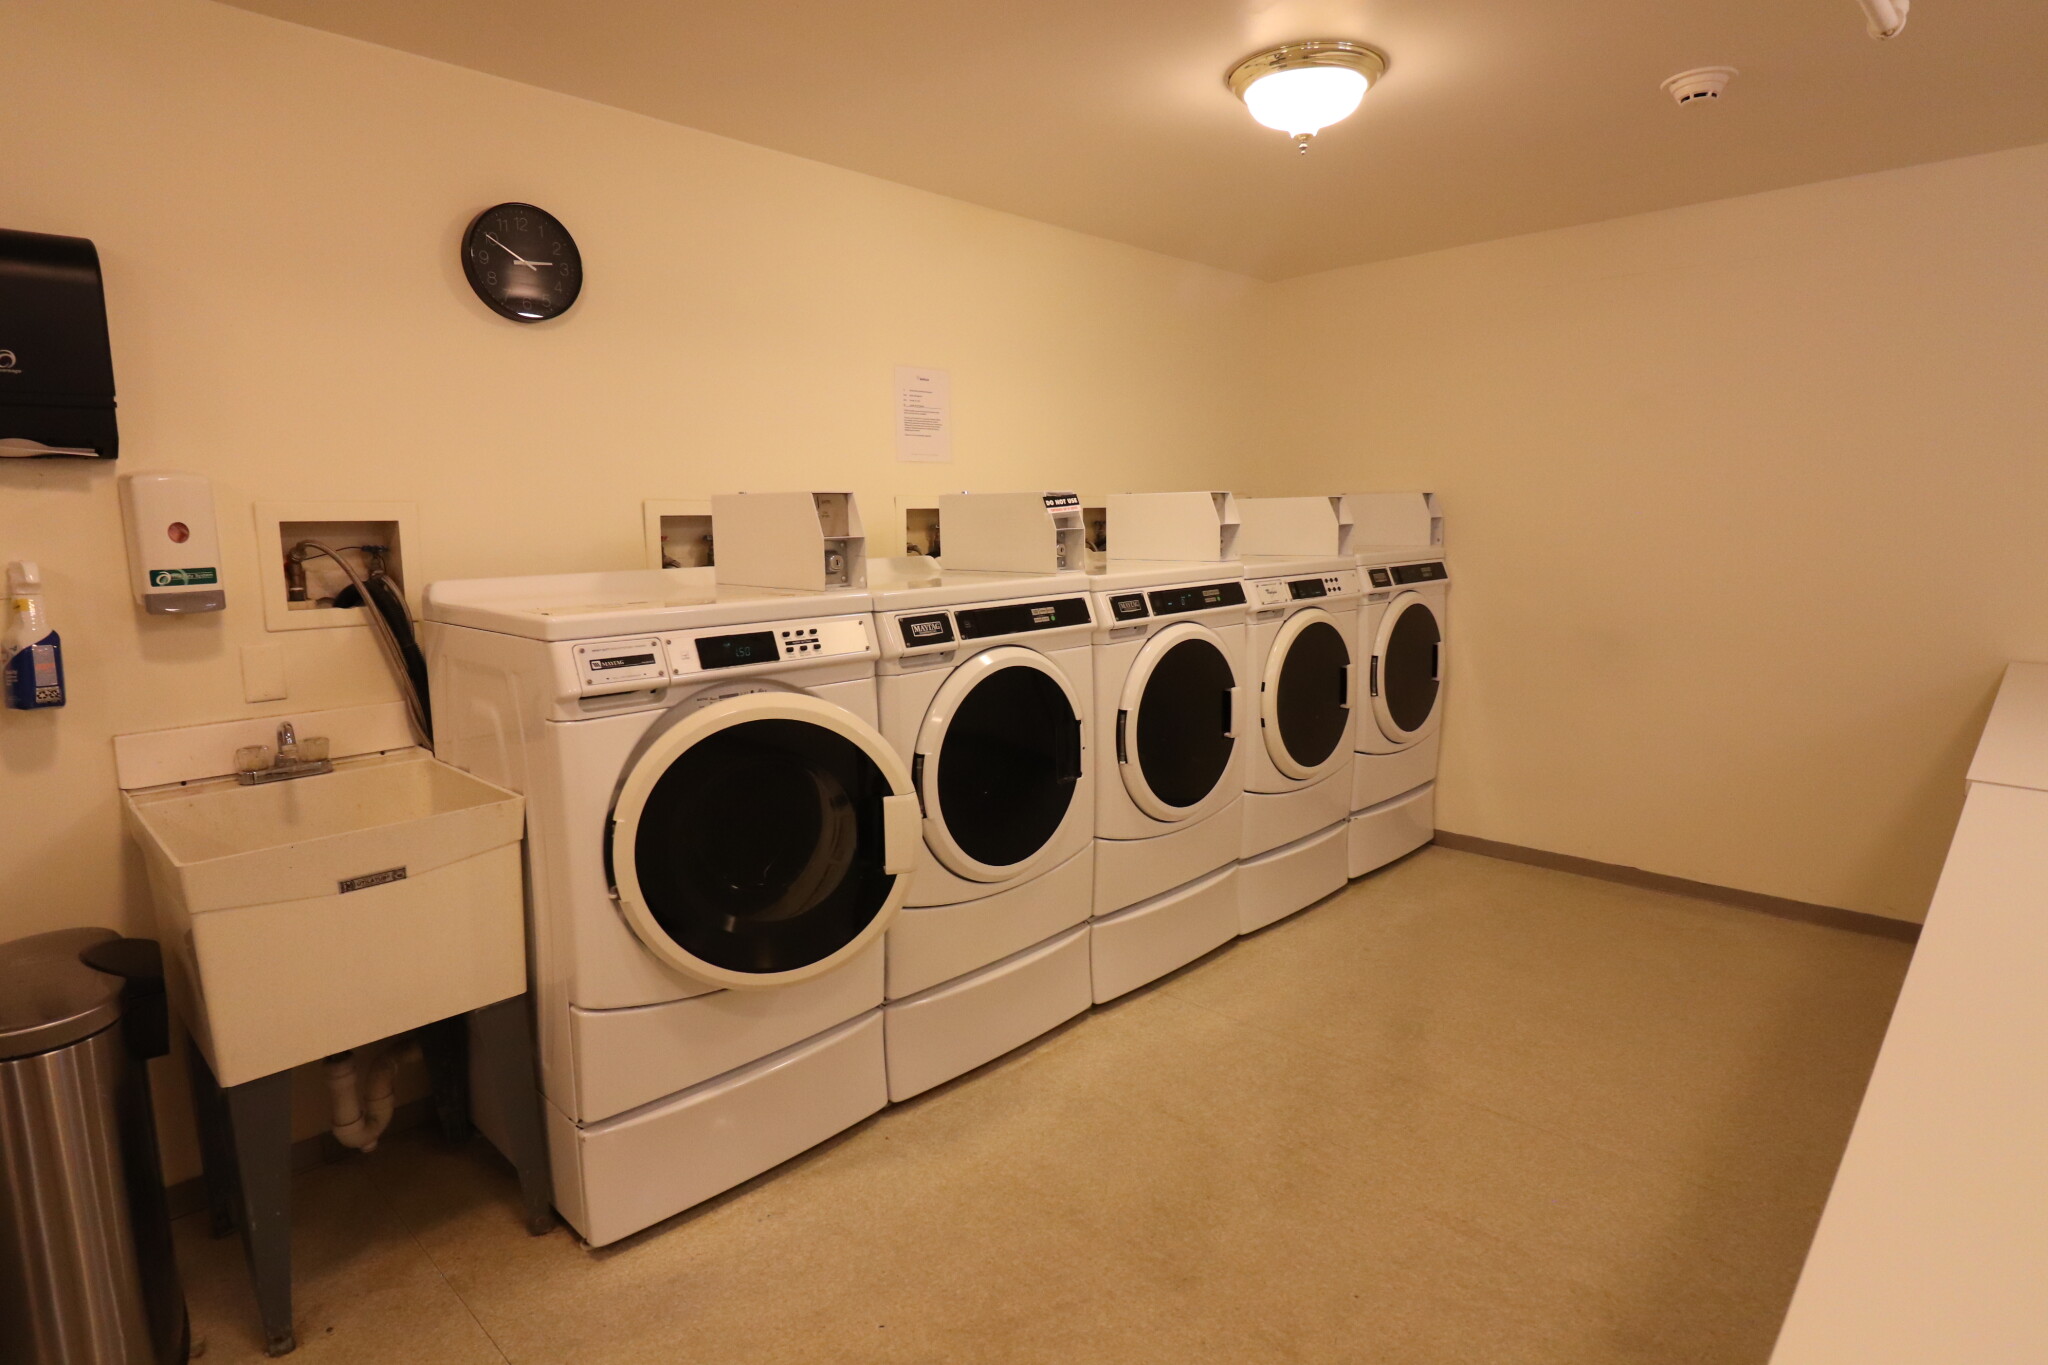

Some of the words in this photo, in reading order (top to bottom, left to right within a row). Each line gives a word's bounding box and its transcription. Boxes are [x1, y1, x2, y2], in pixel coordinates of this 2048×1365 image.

[496, 218, 508, 232] 11
[514, 217, 528, 232] 12
[538, 225, 544, 238] 1
[485, 232, 499, 246] 10
[552, 242, 561, 256] 2
[479, 250, 489, 264] 9
[559, 263, 569, 276] 3
[487, 271, 497, 285] 8
[554, 281, 562, 293] 4
[522, 298, 532, 310] 6
[542, 295, 552, 308] 5
[914, 623, 941, 633] MAYTAG
